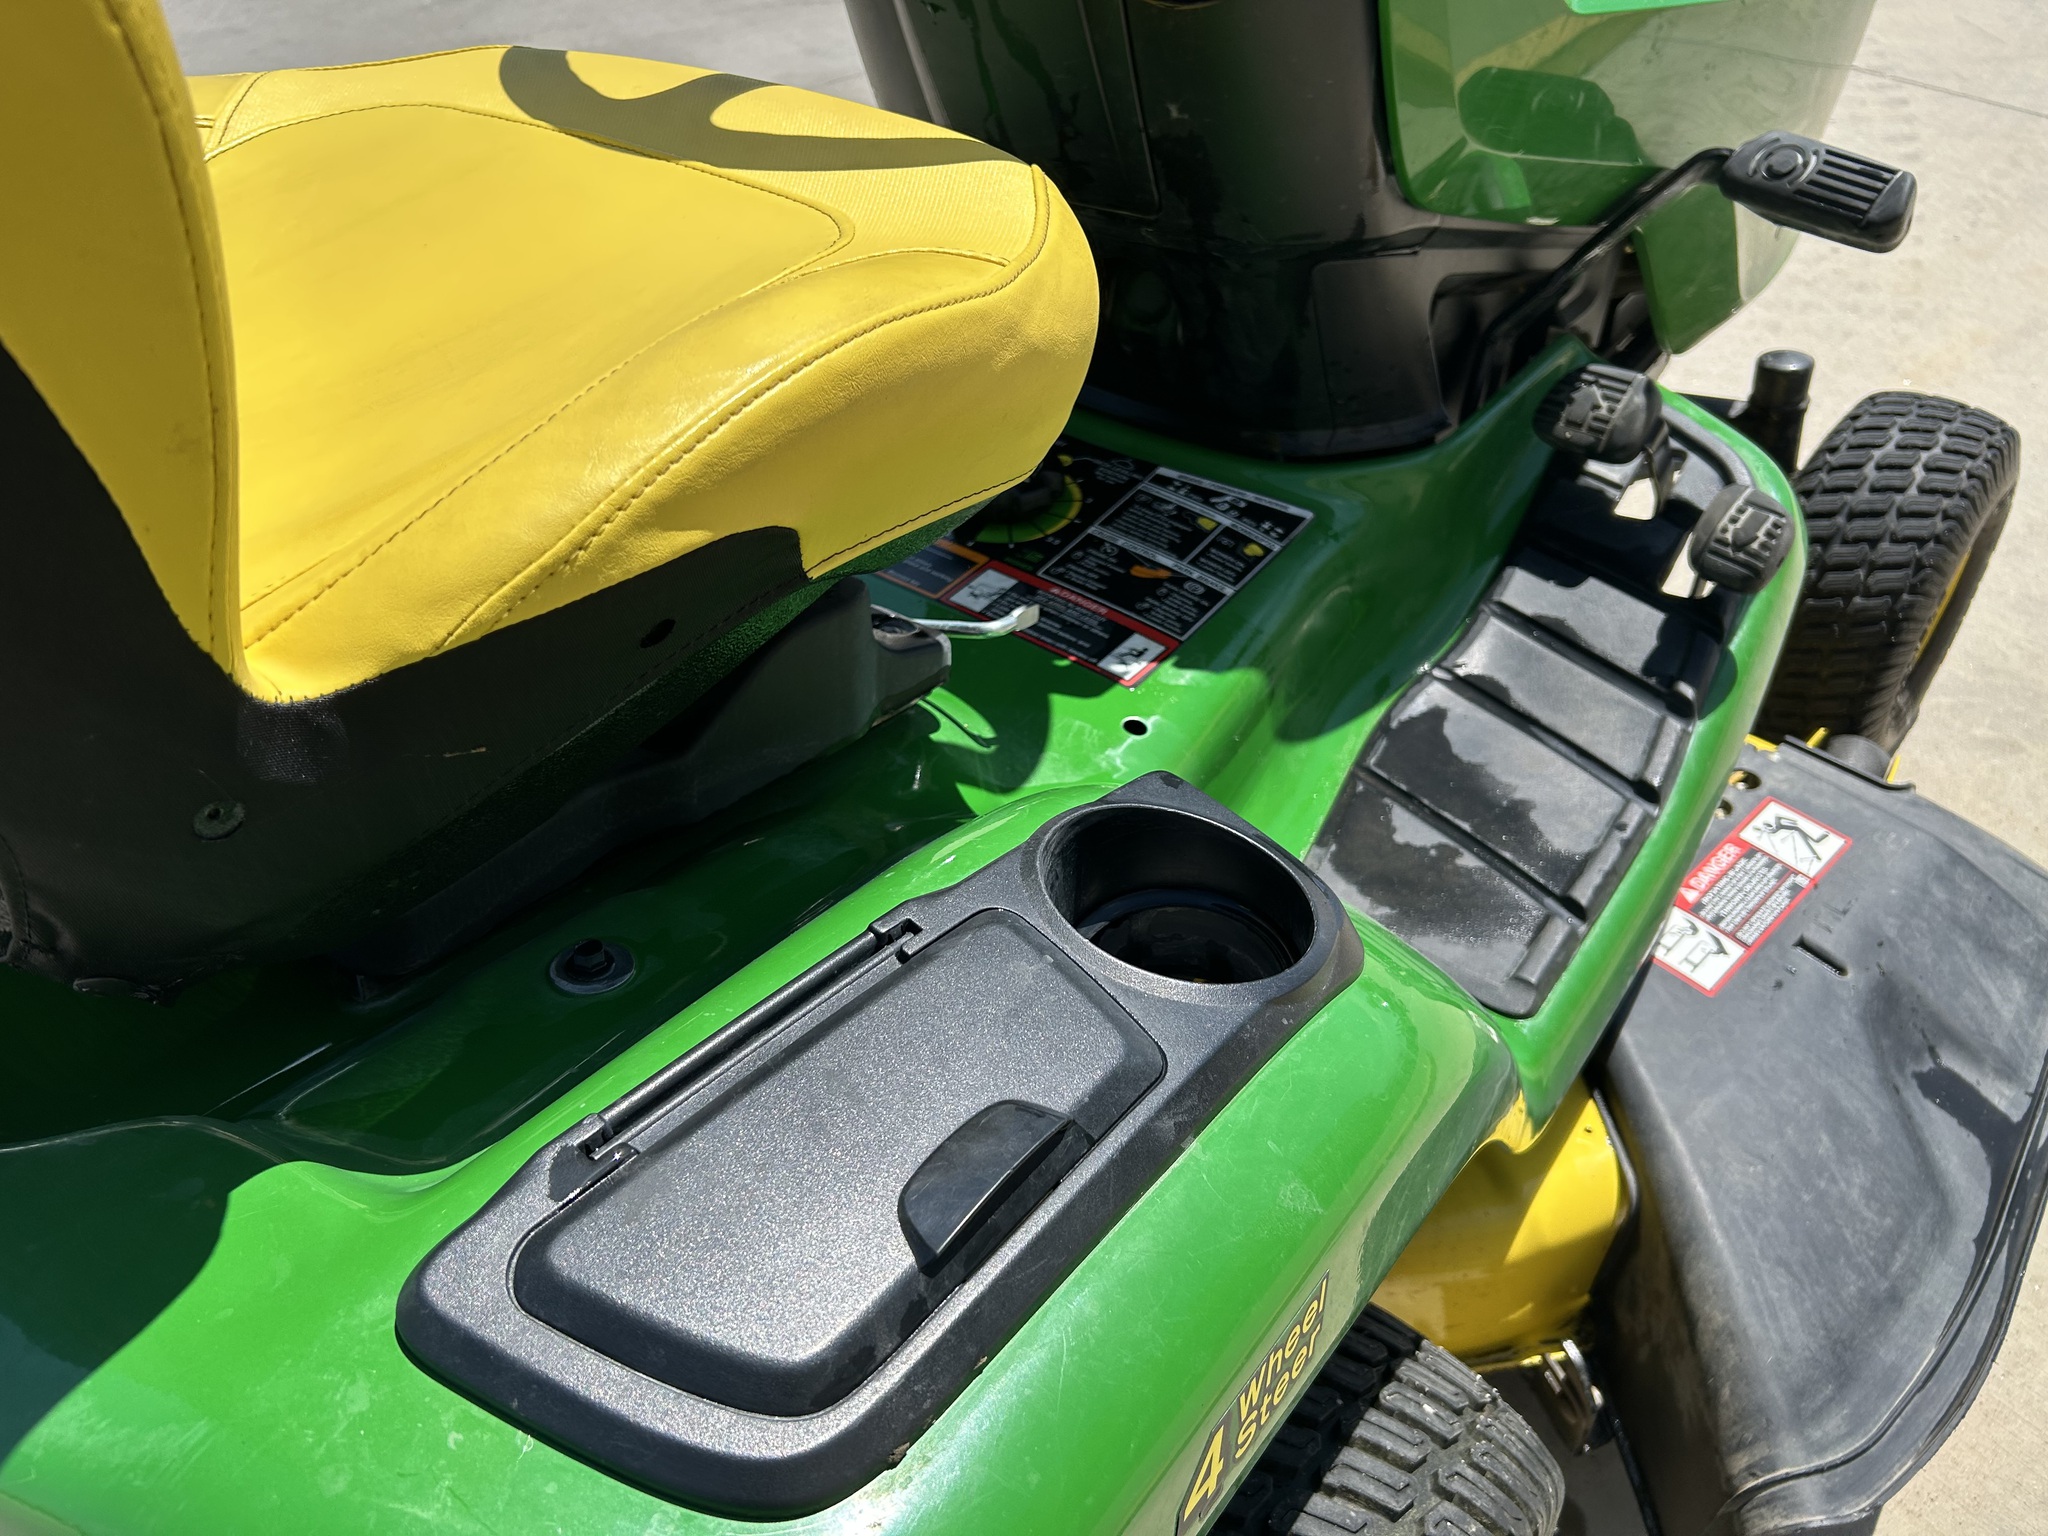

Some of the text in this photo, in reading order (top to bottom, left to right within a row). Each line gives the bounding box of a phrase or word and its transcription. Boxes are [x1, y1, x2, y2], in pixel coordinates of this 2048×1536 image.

[1059, 588, 1108, 615] DANGER
[1688, 842, 1742, 892] DANGER
[1235, 1323, 1321, 1459] Steer
[1239, 1278, 1327, 1422] Wheel
[1183, 1424, 1225, 1522] 4
